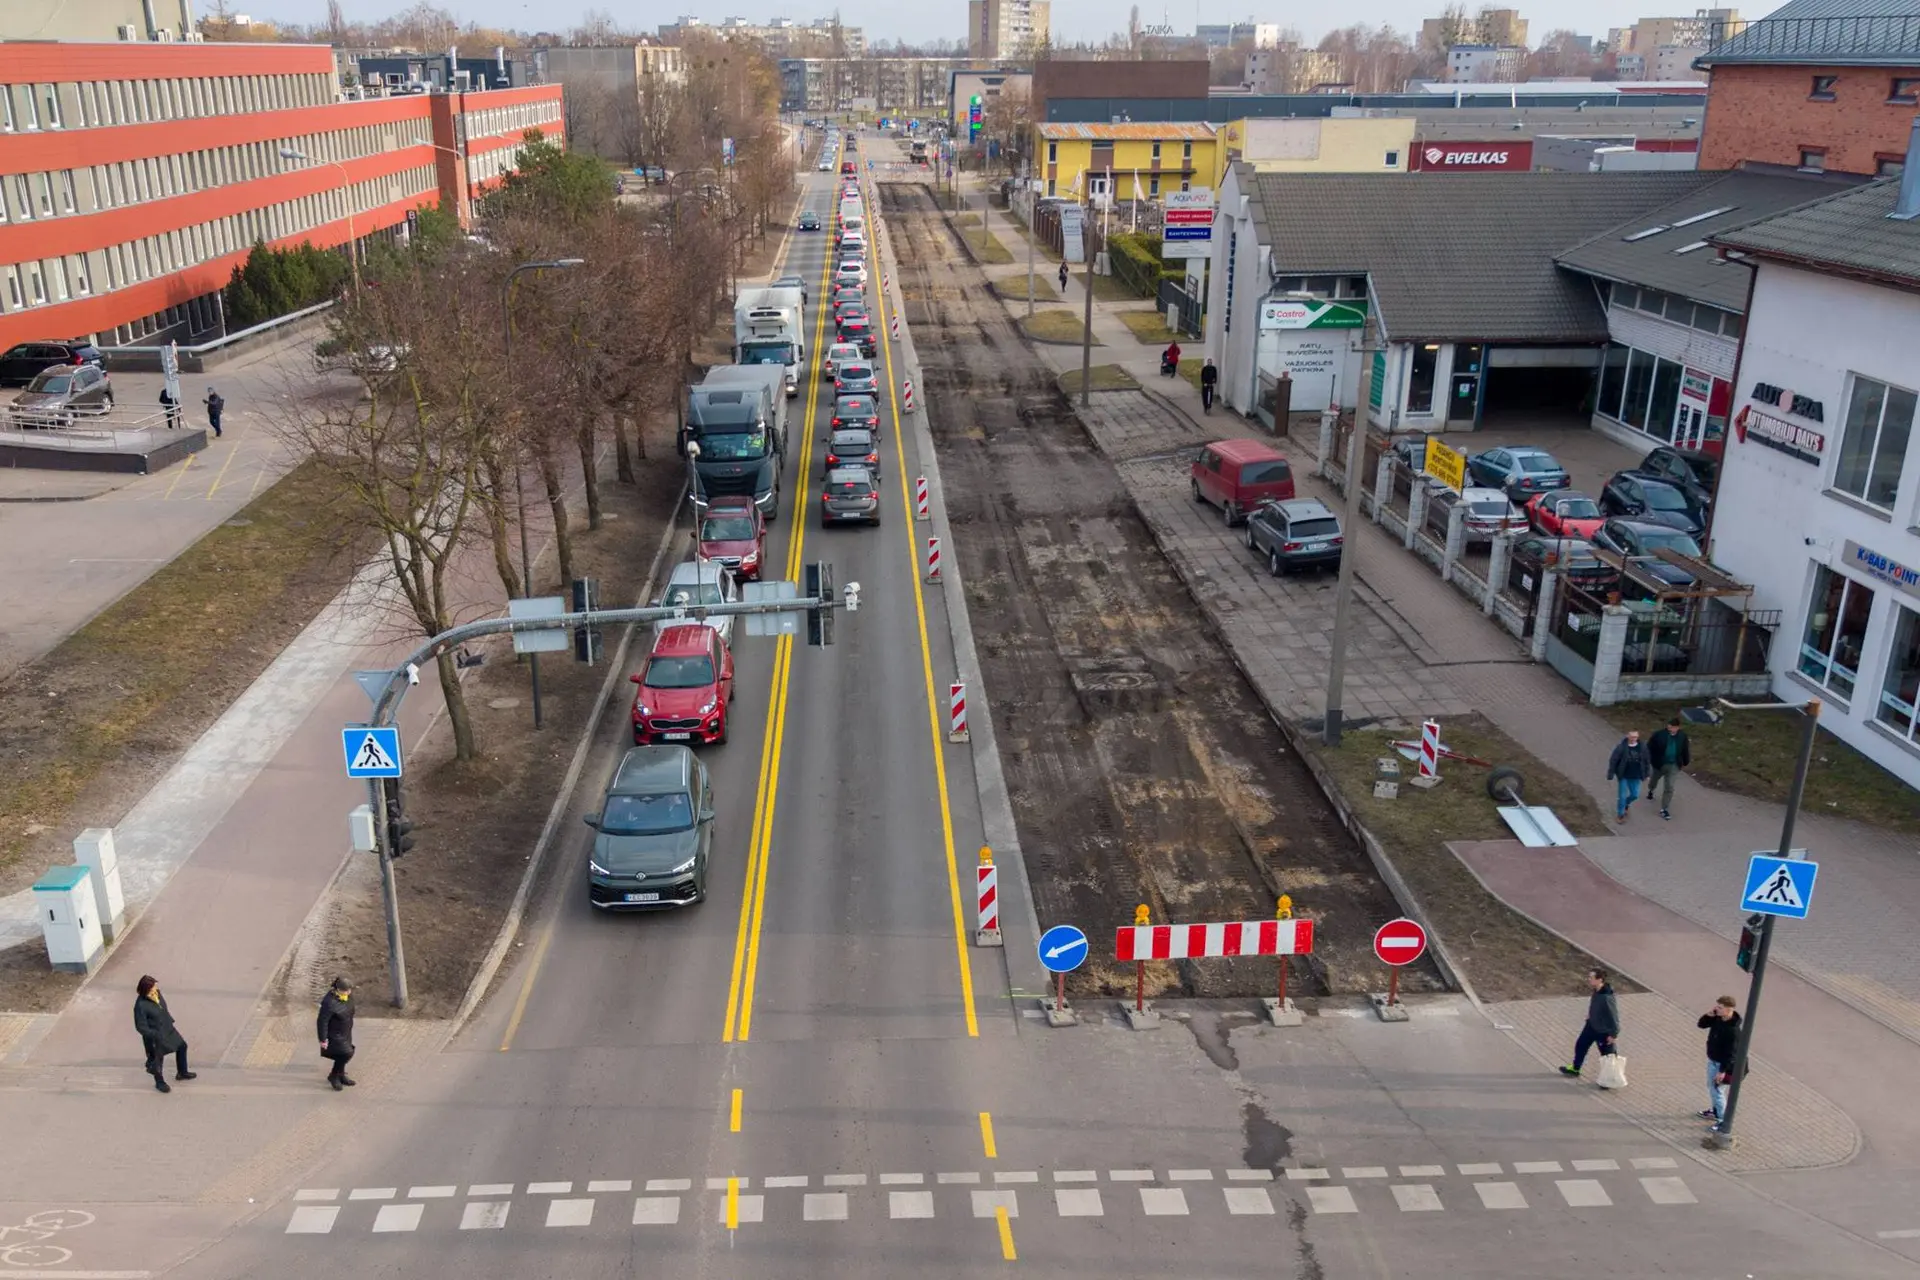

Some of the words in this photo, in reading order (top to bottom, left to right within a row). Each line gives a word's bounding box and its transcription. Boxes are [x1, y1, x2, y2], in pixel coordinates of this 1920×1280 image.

[1145, 25, 1173, 34] TAIKA
[1444, 152, 1509, 164] EVELKAS
[1276, 310, 1306, 318] Castrol
[1796, 428, 1820, 452] DALYS
[1888, 562, 1919, 586] POINT
